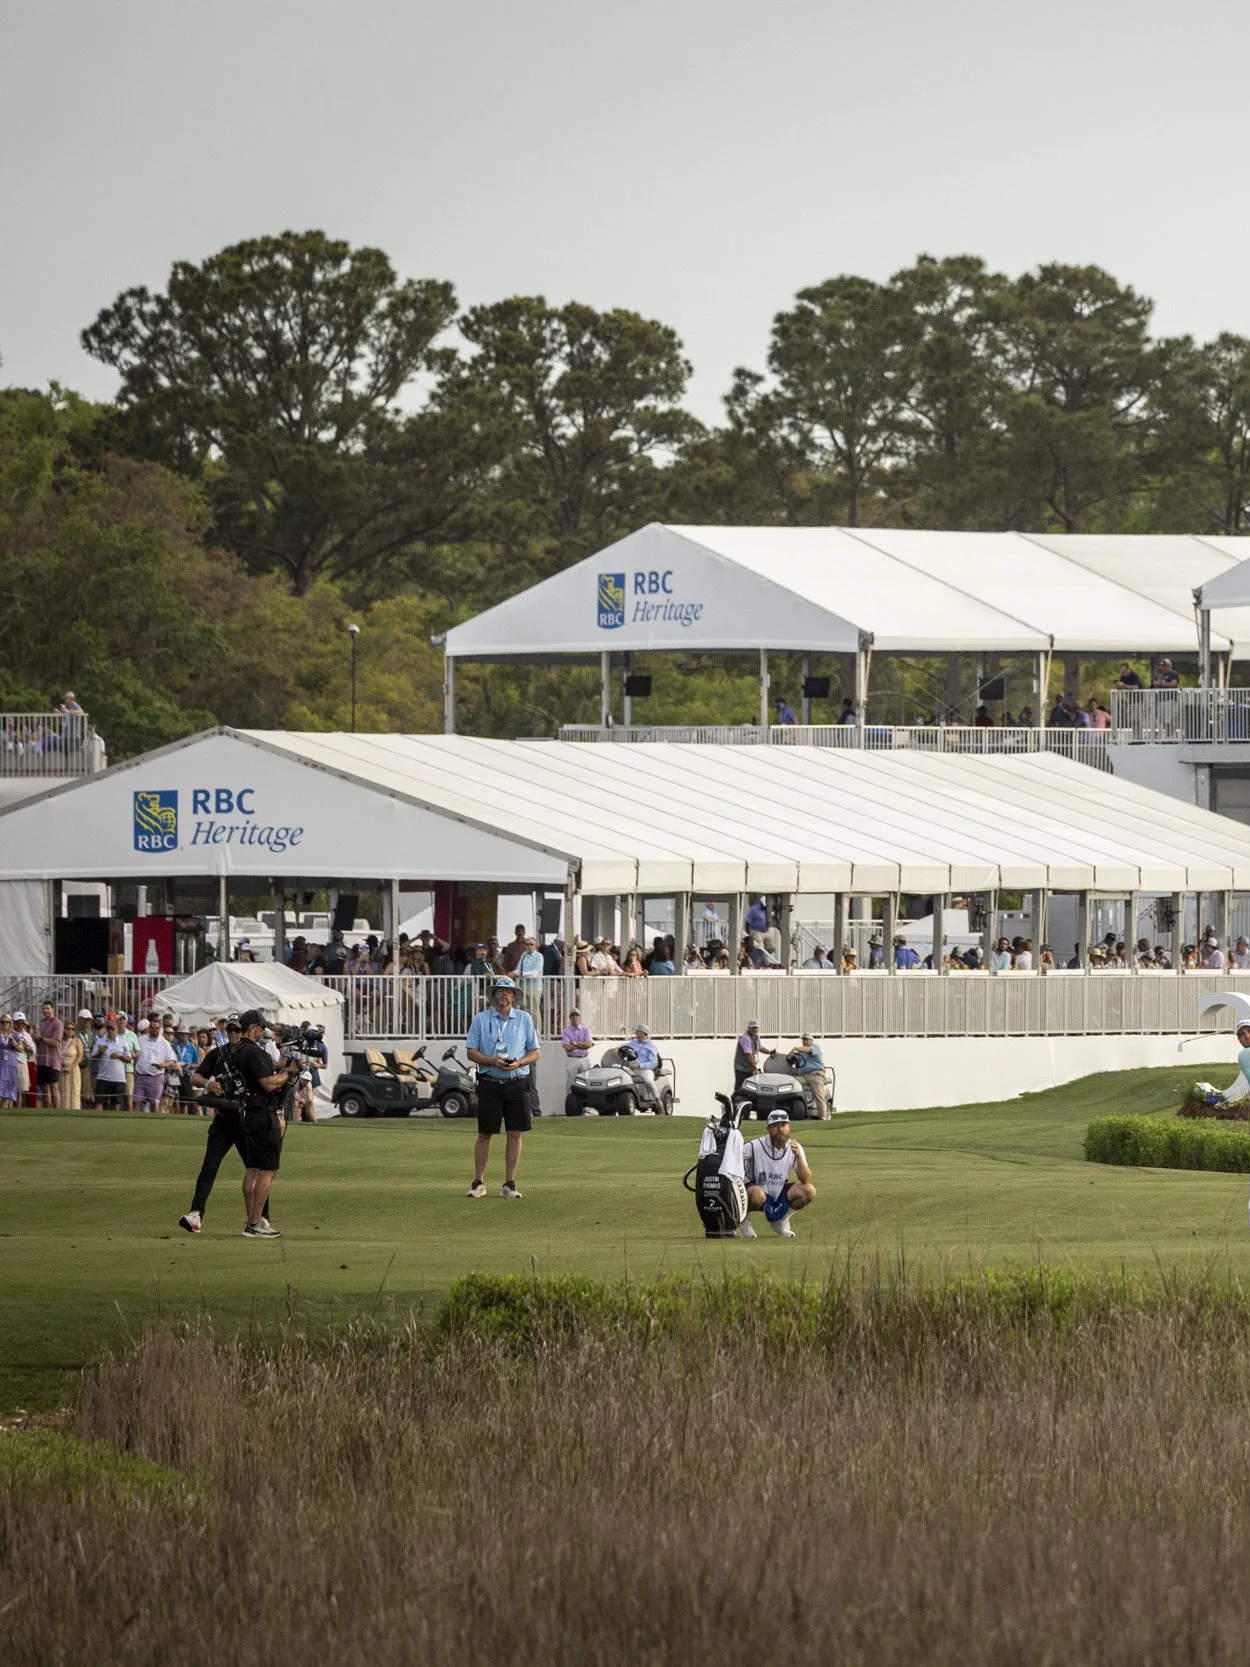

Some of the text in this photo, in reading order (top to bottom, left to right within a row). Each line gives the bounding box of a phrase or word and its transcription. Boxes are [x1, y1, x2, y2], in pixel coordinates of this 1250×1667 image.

[634, 570, 673, 595] RBC
[599, 613, 623, 626] RBC
[632, 599, 703, 627] Heritage
[192, 788, 255, 815] RBC
[138, 834, 175, 849] RBC
[190, 820, 303, 852] Heritage
